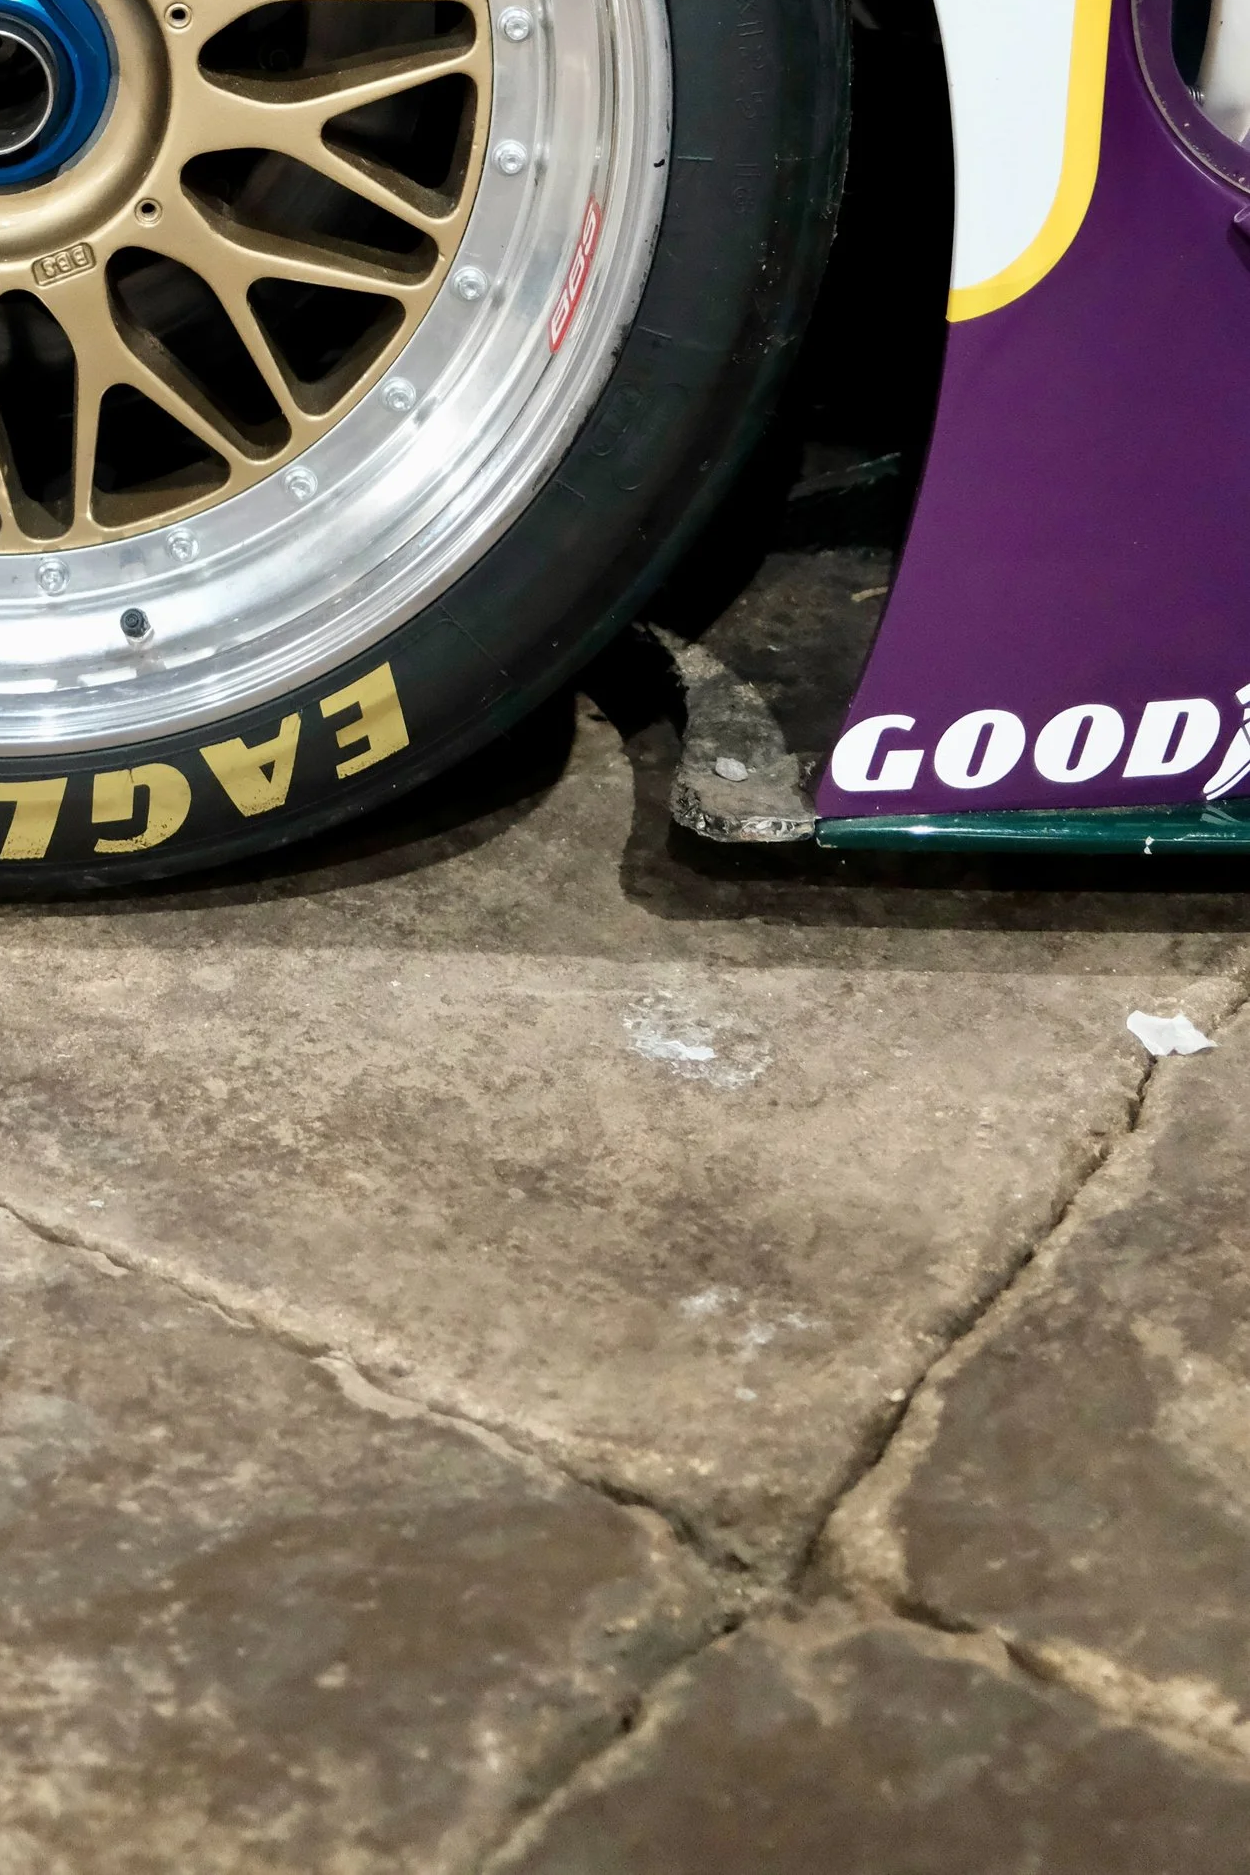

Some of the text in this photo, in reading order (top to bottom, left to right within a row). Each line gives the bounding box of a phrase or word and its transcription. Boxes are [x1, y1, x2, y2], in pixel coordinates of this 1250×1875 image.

[40, 244, 89, 279] BBS
[551, 202, 598, 346] BBS
[831, 698, 1221, 792] GOOD
